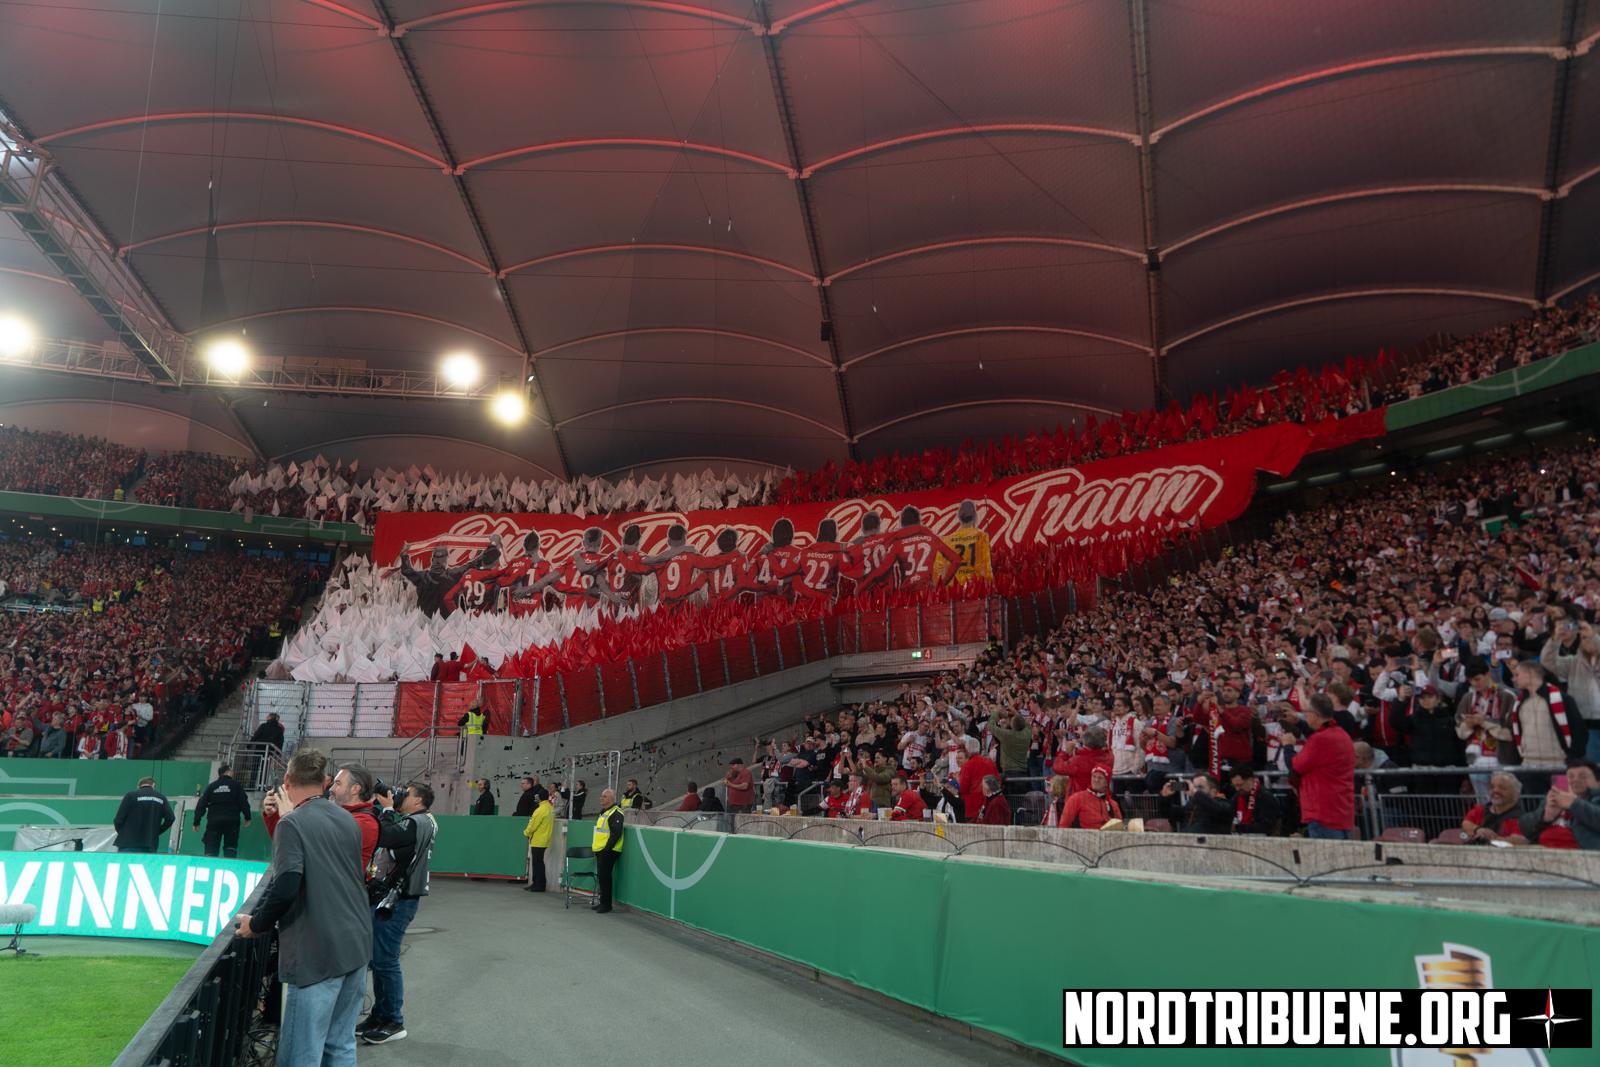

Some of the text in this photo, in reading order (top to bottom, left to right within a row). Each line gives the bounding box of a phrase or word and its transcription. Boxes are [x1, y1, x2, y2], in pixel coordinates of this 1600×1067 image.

[1009, 472, 1212, 545] Traum
[903, 542, 932, 576] 32
[954, 542, 976, 567] 21
[613, 562, 627, 590] 8
[666, 561, 681, 591] 9
[713, 563, 735, 594] 14
[803, 559, 830, 590] 22
[463, 580, 486, 606] 29
[925, 649, 931, 659] 4
